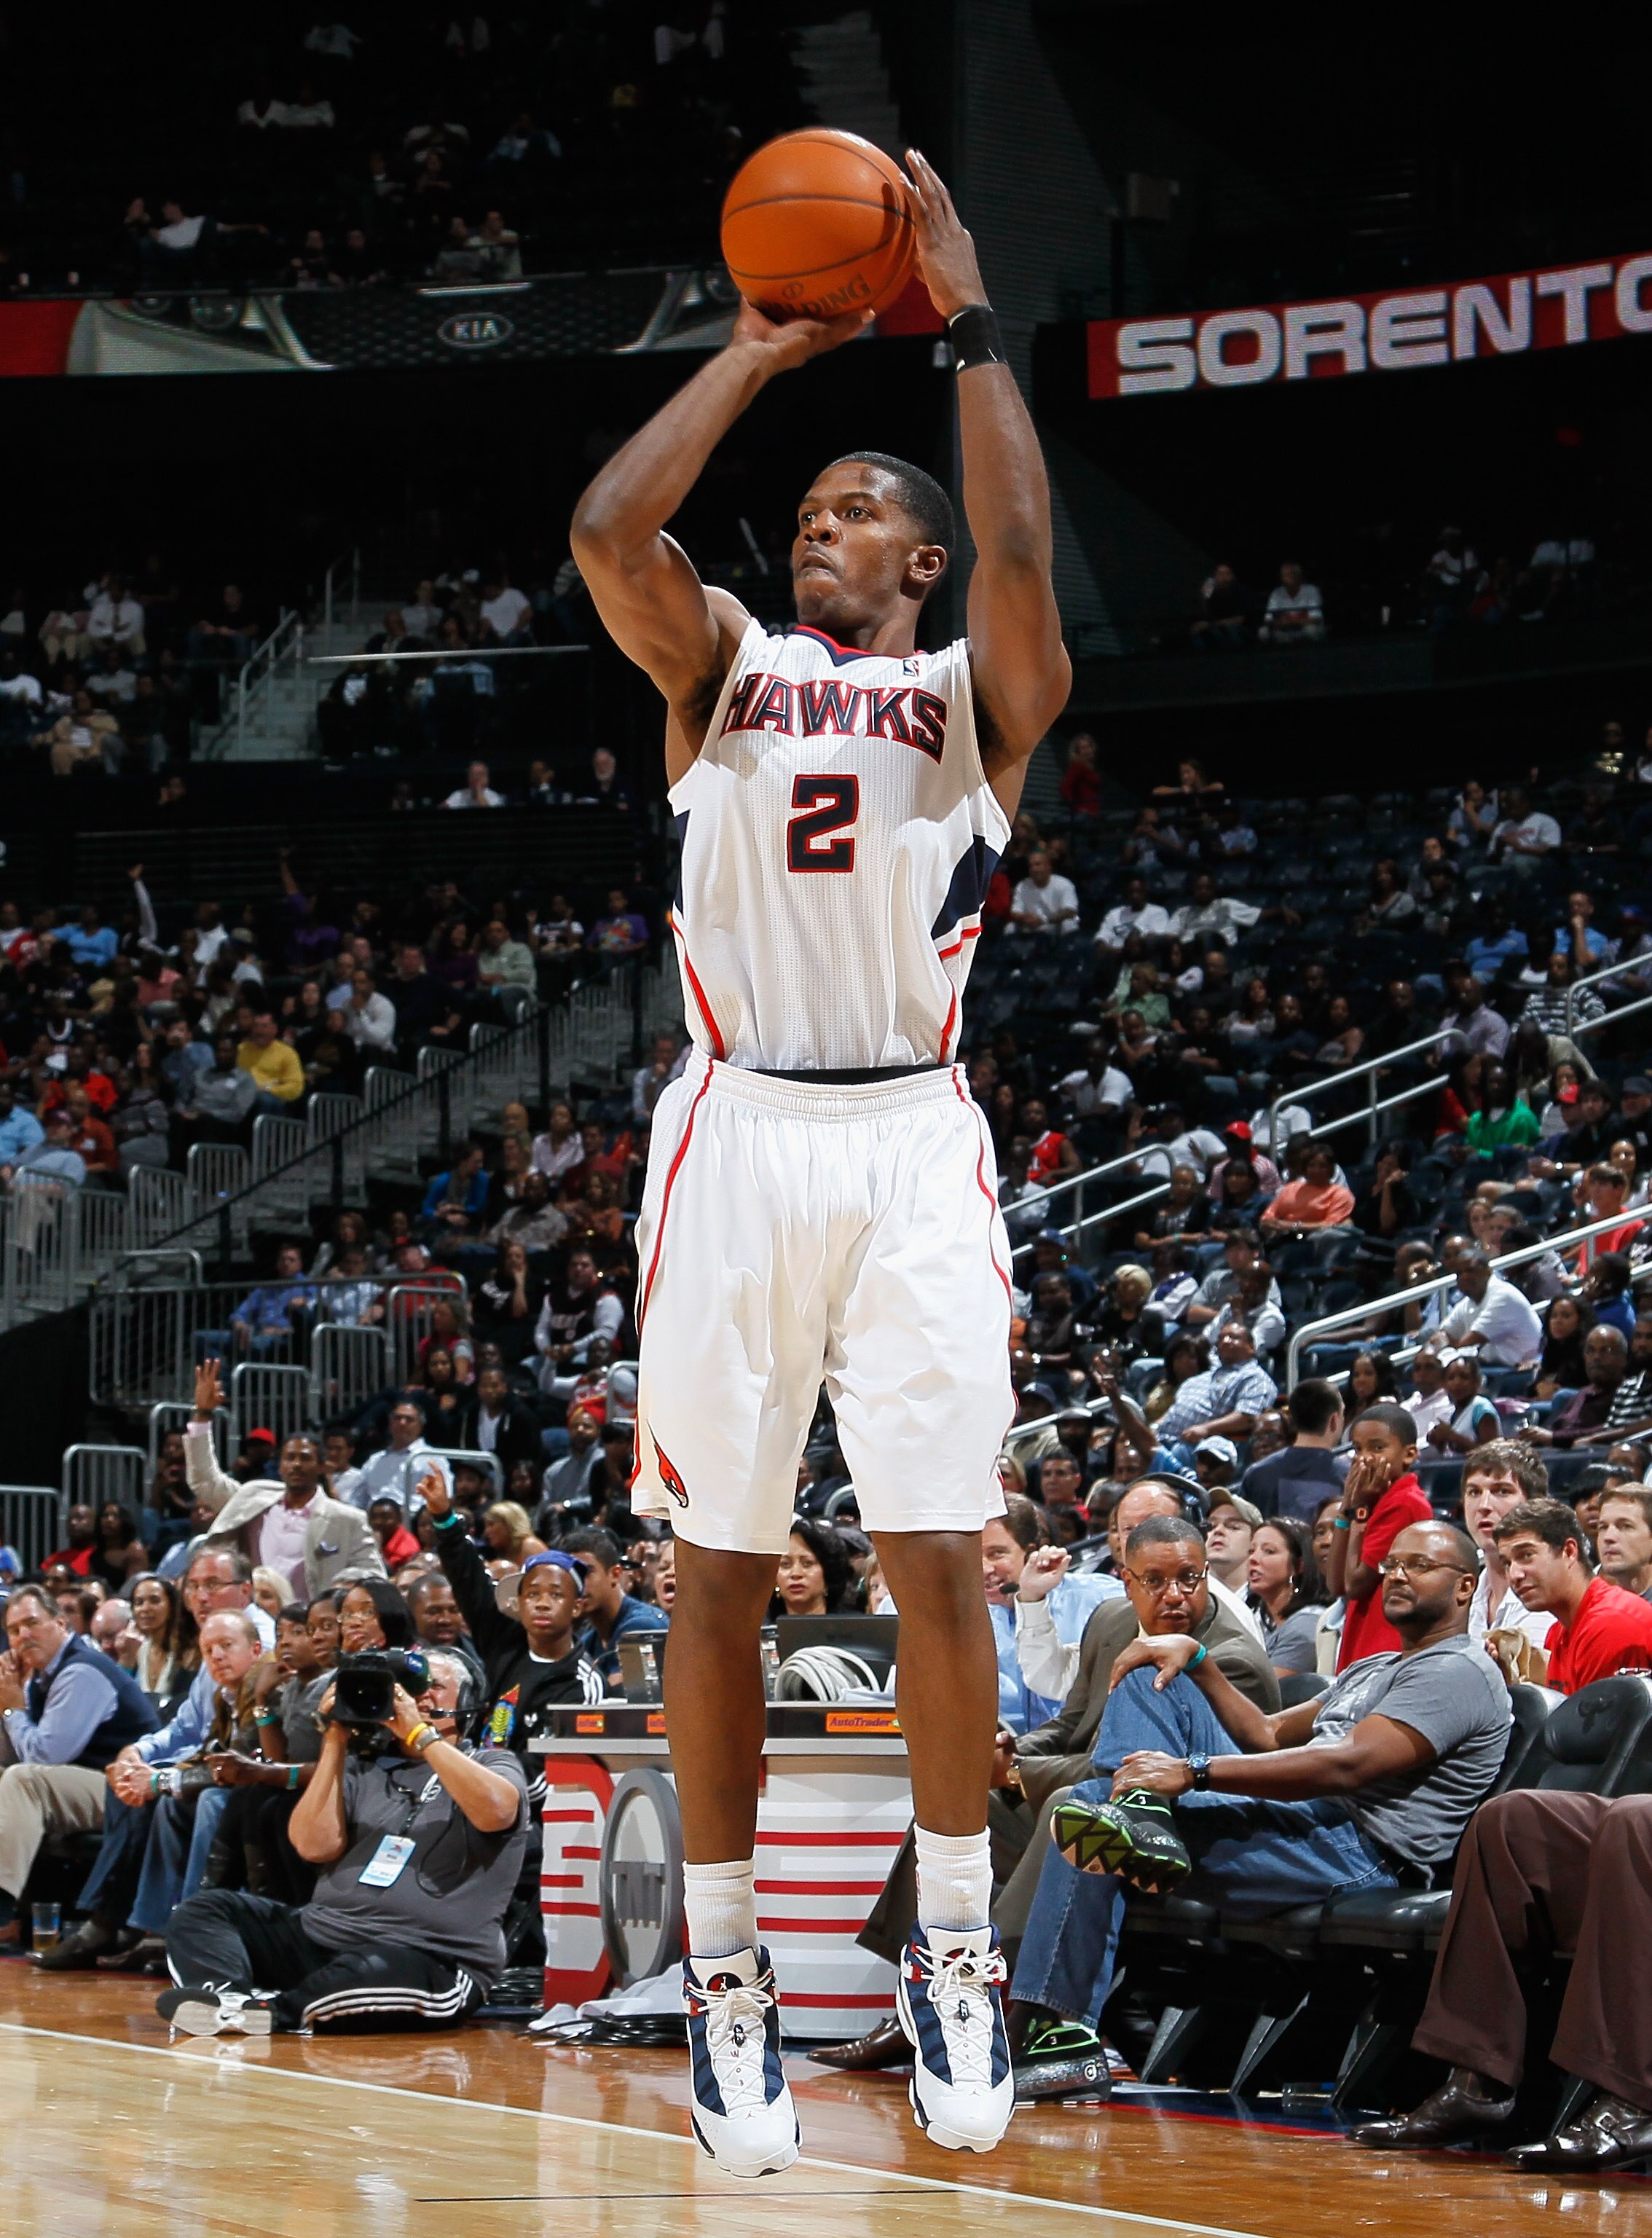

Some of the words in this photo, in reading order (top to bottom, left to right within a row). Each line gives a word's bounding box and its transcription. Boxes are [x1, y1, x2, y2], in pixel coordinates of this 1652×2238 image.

[453, 320, 498, 339] KIA
[719, 673, 947, 765] HAWKS
[787, 774, 860, 873] 2
[830, 1717, 892, 1727] AutoTrader
